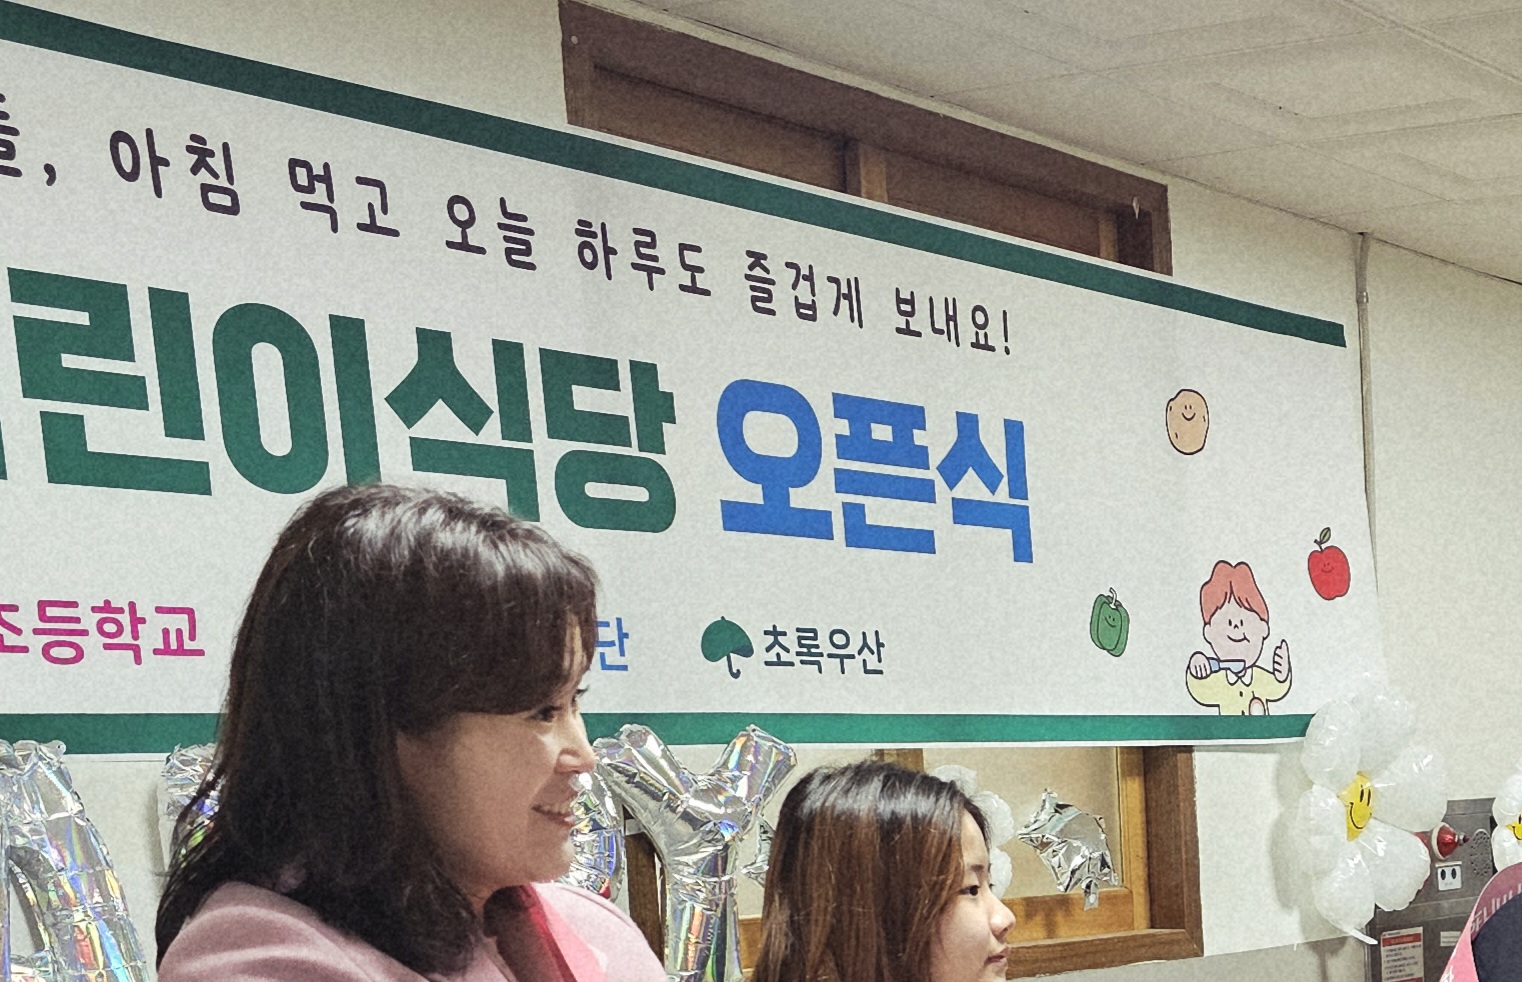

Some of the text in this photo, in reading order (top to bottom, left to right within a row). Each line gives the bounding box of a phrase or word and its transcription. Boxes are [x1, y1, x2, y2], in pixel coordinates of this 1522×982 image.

[109, 127, 240, 216] 아침
[288, 157, 401, 238] 먹고
[445, 195, 537, 271] 오늘
[575, 219, 711, 298] 하루도
[744, 250, 863, 328] 즐겁게
[895, 291, 1012, 355] 보내요!
[0, 267, 1034, 563] 린이식당 오픈식
[763, 625, 886, 675] 초록우산
